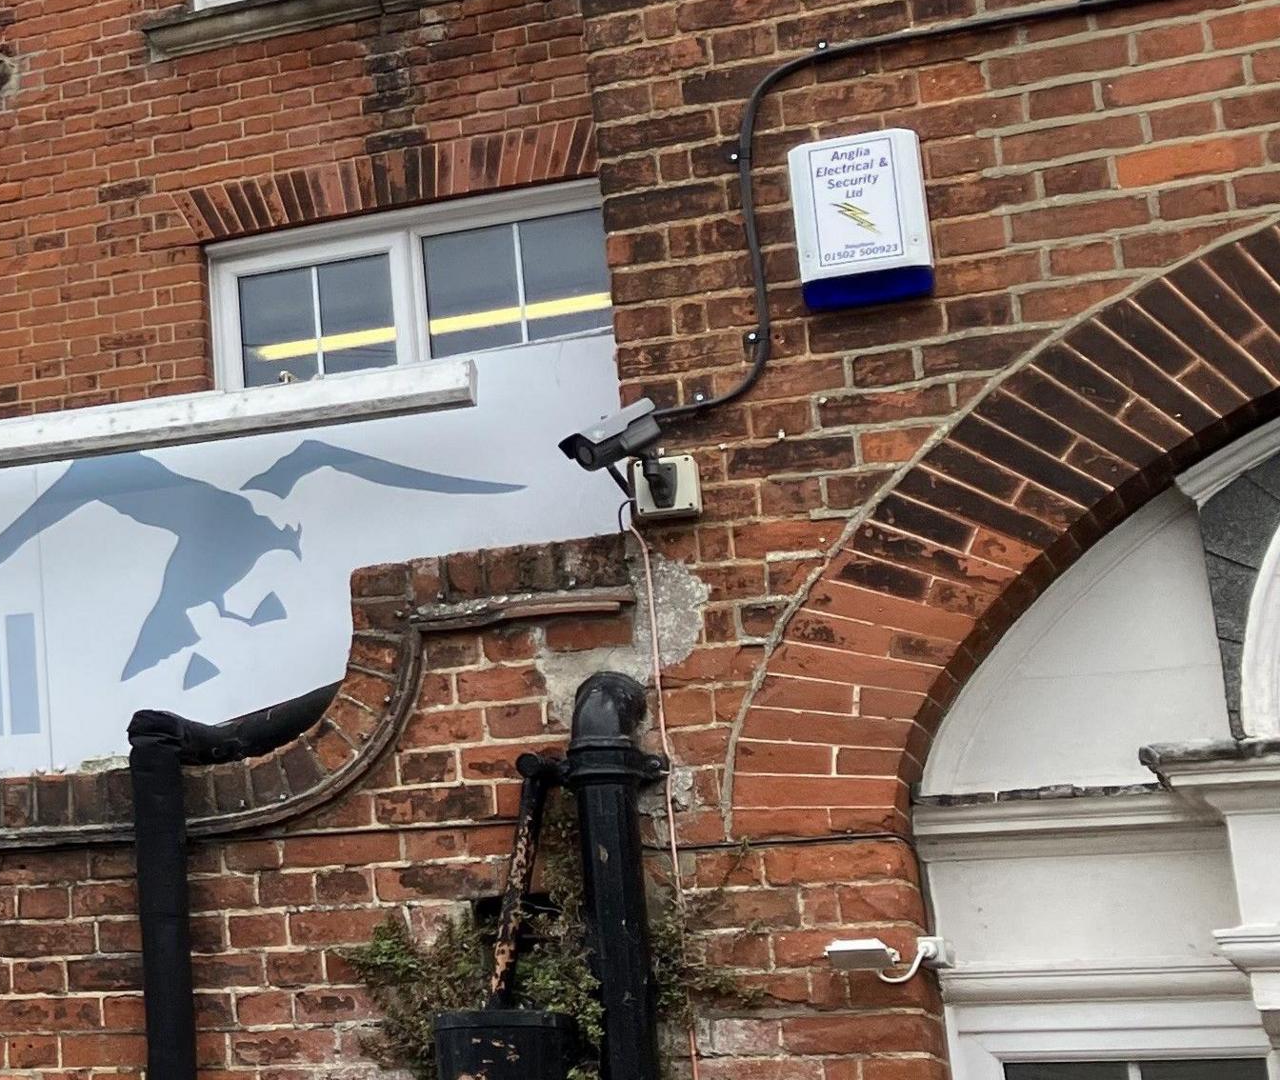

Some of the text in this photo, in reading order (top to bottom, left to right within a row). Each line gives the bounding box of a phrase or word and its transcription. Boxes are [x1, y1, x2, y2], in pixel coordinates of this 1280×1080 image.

[831, 147, 870, 161] Anglia
[816, 157, 888, 177] Electrical &
[827, 174, 878, 189] Security
[845, 187, 863, 198] Ltd
